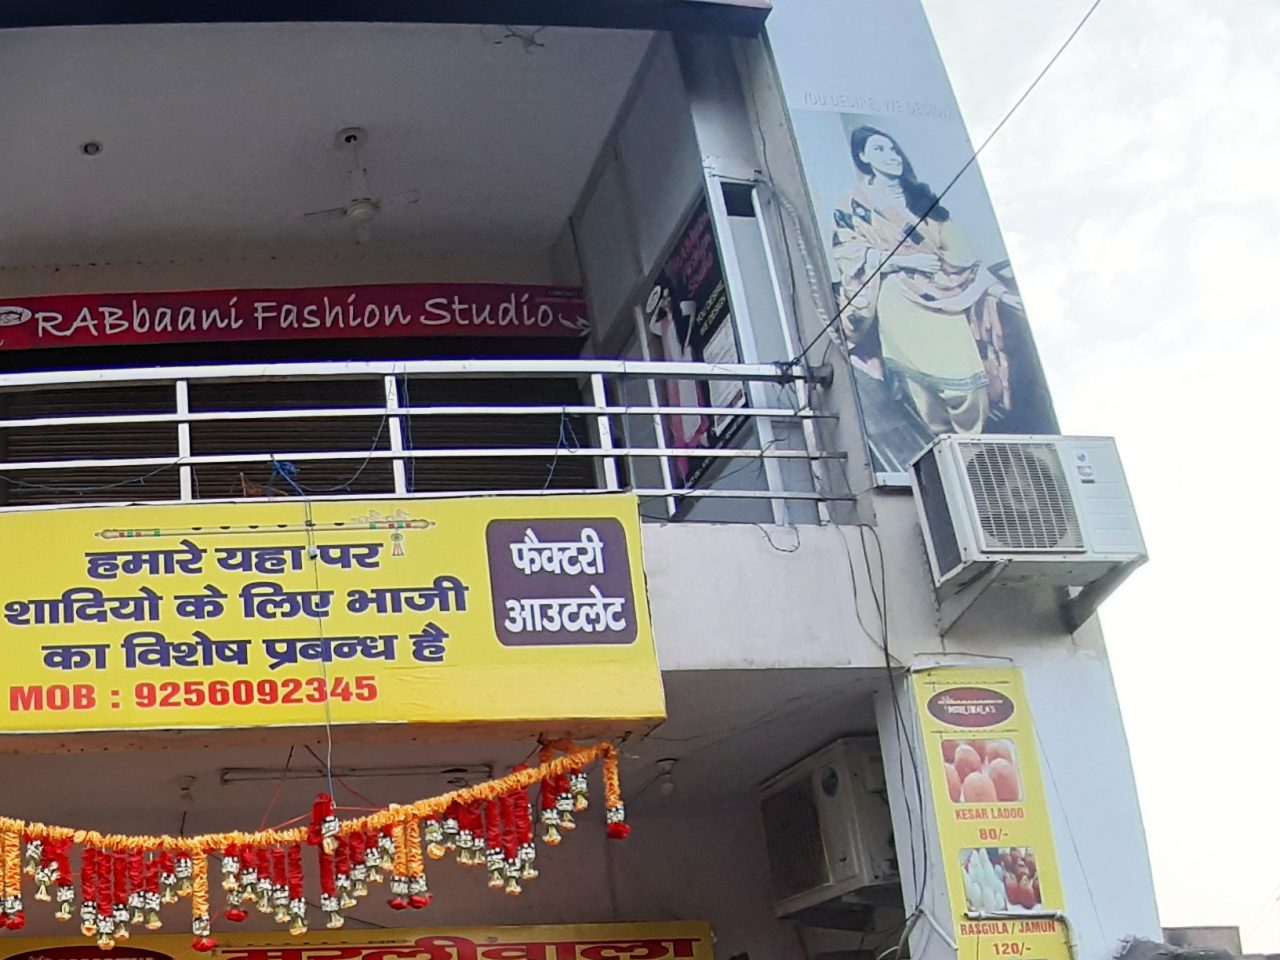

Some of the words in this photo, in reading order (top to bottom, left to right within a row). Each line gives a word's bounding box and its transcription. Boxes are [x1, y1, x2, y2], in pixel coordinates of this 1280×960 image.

[253, 294, 411, 331] Fashion
[420, 293, 554, 327] Studio
[85, 538, 206, 580] हमारे
[314, 541, 384, 570] पर
[510, 527, 605, 578] फैक्टरी
[4, 585, 161, 627] शादियो
[175, 583, 233, 621] के
[239, 581, 332, 622] लिए
[346, 575, 468, 614] भाजी
[503, 584, 627, 635] आउटलेट
[42, 641, 110, 671] का
[121, 629, 251, 669] विशेष
[261, 632, 399, 672] प्रबन्ध
[408, 622, 449, 663] है
[8, 685, 99, 712] MOB
[134, 676, 379, 708] 9256092345
[954, 807, 989, 821] KESAR
[991, 806, 1024, 820] LADOO
[978, 828, 1009, 841] 80/-
[960, 923, 1009, 936] RASGULA
[1018, 920, 1056, 934] JAMUN
[992, 942, 1031, 956] 120/-
